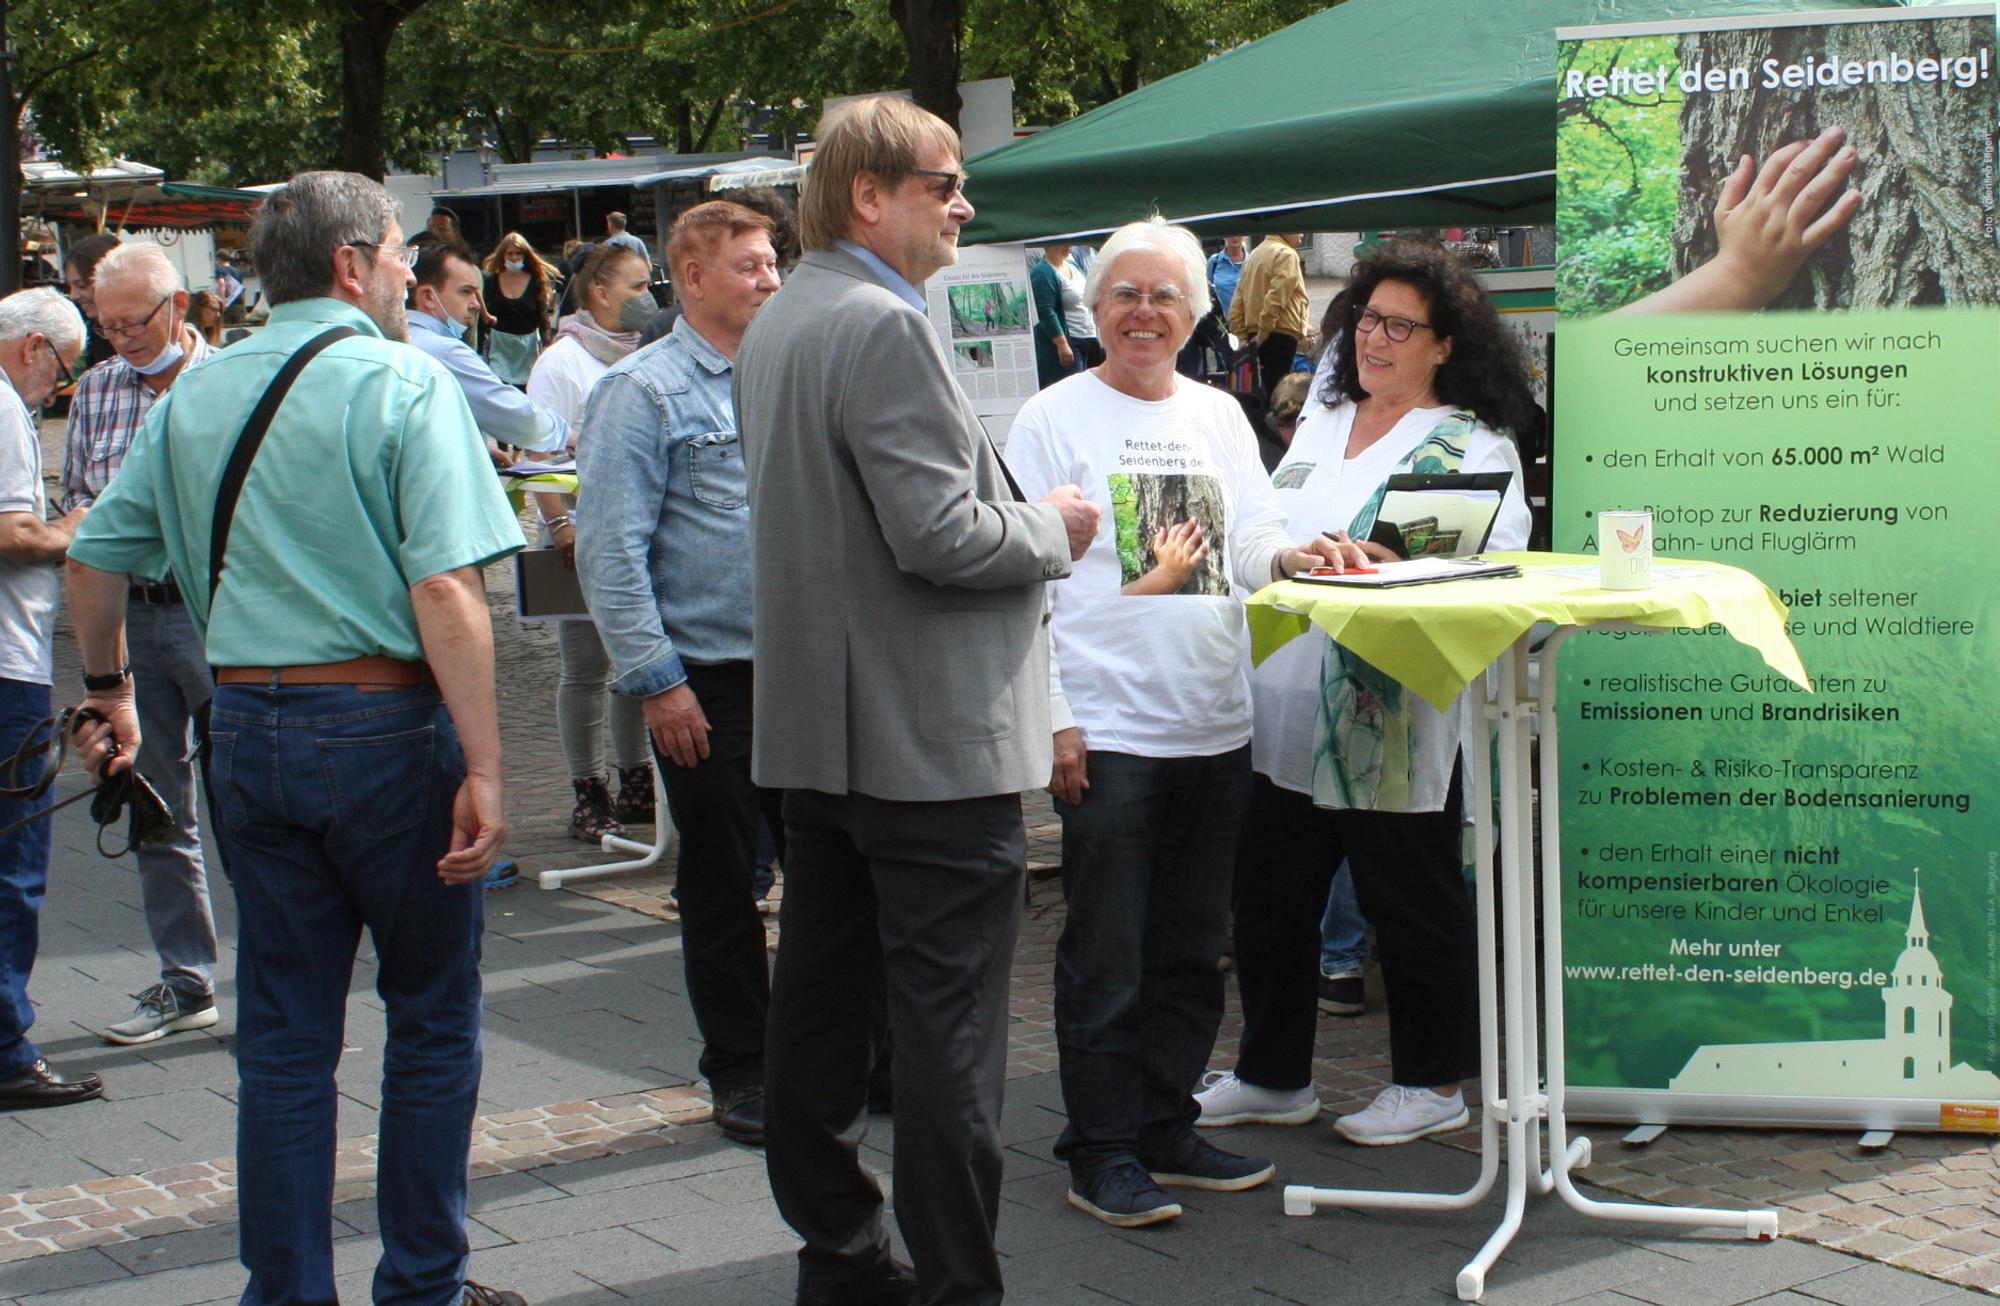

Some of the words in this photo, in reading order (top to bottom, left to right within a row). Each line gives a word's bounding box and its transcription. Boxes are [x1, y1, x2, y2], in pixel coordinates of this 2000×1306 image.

[1566, 65, 1669, 98] Rettet
[1680, 61, 1748, 93] den
[1761, 49, 1990, 88] Seidenberg!
[1983, 214, 1995, 238] Foto:
[1615, 337, 1748, 356] Gemeinsam
[1757, 335, 1837, 353] suchen
[1845, 332, 1876, 350] wir
[1883, 331, 1940, 350] nach
[1648, 364, 1793, 383] konstruktiven
[1802, 362, 1907, 383] Lösungen
[1655, 393, 1696, 411] und
[1705, 392, 1773, 410] setzen
[1782, 395, 1818, 409] uns
[1826, 390, 1858, 408] ein
[1867, 389, 1899, 407] für:
[1119, 455, 1204, 469] Seidenberg.de
[1603, 450, 1646, 468] den
[1656, 449, 1715, 467] Erhalt
[1723, 452, 1763, 466] von
[1772, 447, 1842, 465] 65.000
[1851, 446, 1879, 464] m²
[1887, 445, 1944, 463] Wald
[1721, 509, 1752, 522] zur
[1760, 503, 1897, 525] Reduzierung
[1906, 506, 1947, 520] von
[1711, 533, 1753, 551] und
[1762, 532, 1855, 555] Fluglärm
[1829, 589, 1917, 607] seltener
[1814, 617, 1856, 635] und
[1866, 616, 1974, 635] Waldtiere
[1601, 673, 1723, 692] realistische
[1863, 679, 1886, 693] zu
[1581, 702, 1702, 720] Emissionen
[1711, 702, 1753, 721] und
[1762, 703, 1899, 721] Brandrisiken
[1601, 758, 1682, 777] Kosten-
[1691, 760, 1706, 777] &
[1715, 758, 1918, 785] Risiko-Transparenz
[1578, 790, 1601, 805] zu
[1611, 787, 1731, 806] Problemen
[1739, 788, 1776, 806] der
[1784, 788, 1969, 813] Bodensanierung
[1599, 843, 1643, 862] den
[1652, 844, 1713, 863] Erhalt
[1720, 845, 1776, 865] einer
[1784, 845, 1840, 864] nicht
[1579, 871, 1778, 894] kompensierbaren
[1785, 870, 1890, 898] Ökologie
[1578, 899, 1606, 918] für
[1613, 904, 1686, 920] unsere
[1695, 901, 1765, 920] Kinder
[1773, 904, 1816, 922] und
[1825, 904, 1882, 923] Enkel
[1670, 939, 1722, 956] Mehr
[1729, 940, 1781, 957] unter
[1565, 964, 1887, 989] www.rettet-den-seidenberg.de
